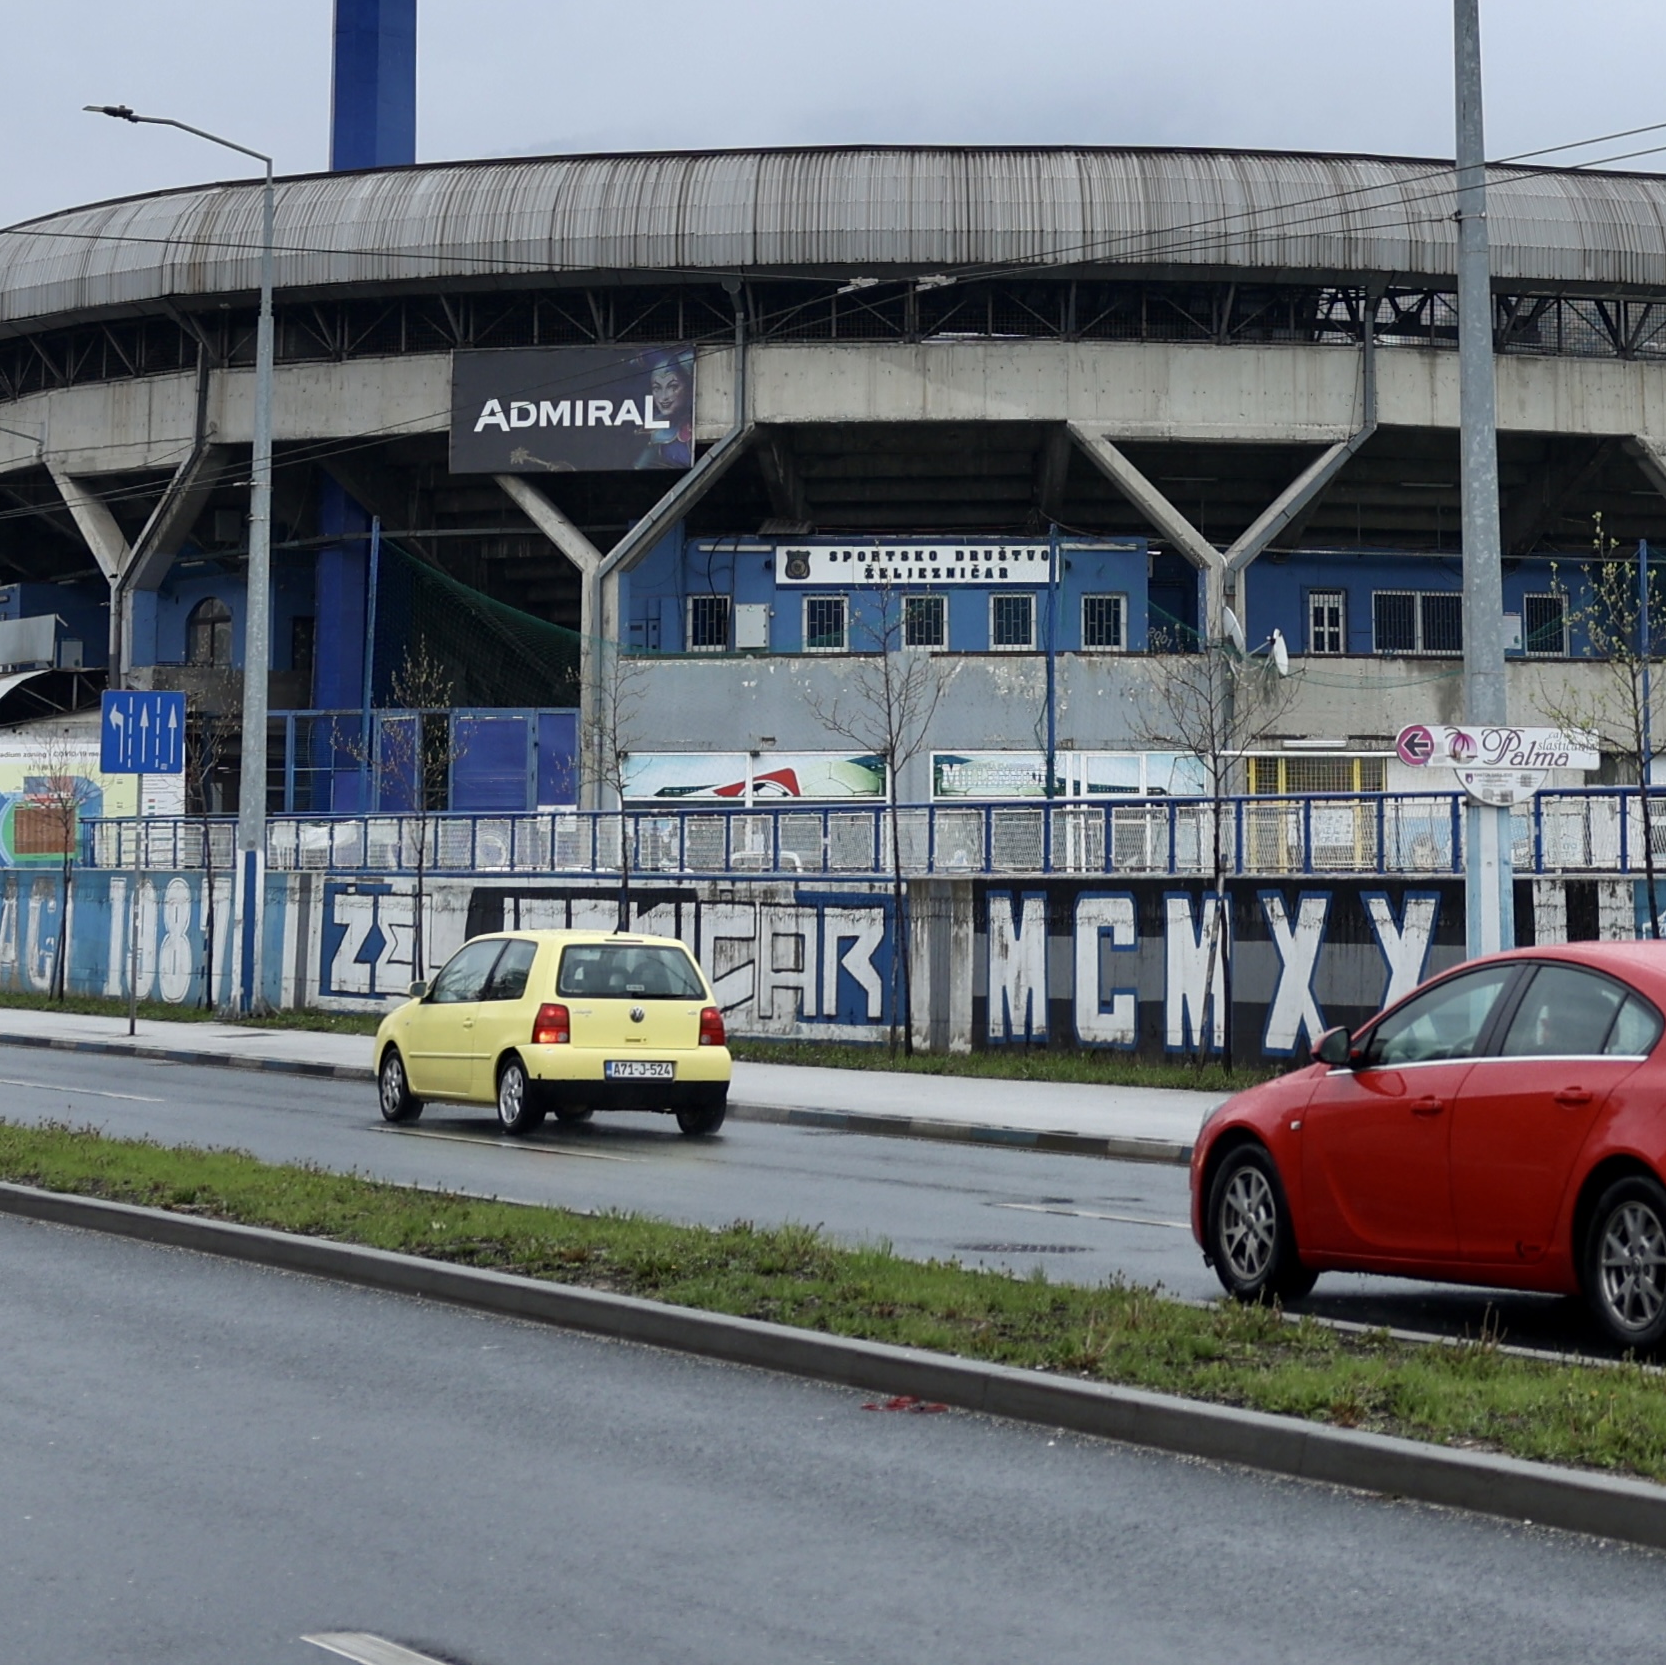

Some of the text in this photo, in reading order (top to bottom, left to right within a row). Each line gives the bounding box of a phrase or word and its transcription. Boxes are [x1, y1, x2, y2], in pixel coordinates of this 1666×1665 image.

[473, 395, 671, 432] ADMIRAL
[828, 546, 1051, 563] SPORTSKO DRUŠTVO
[864, 563, 1009, 580] ŽELJEZNIČAR
[1480, 727, 1570, 767] Palma
[102, 876, 232, 1005] 1987
[613, 1063, 672, 1076] A71-J-524
